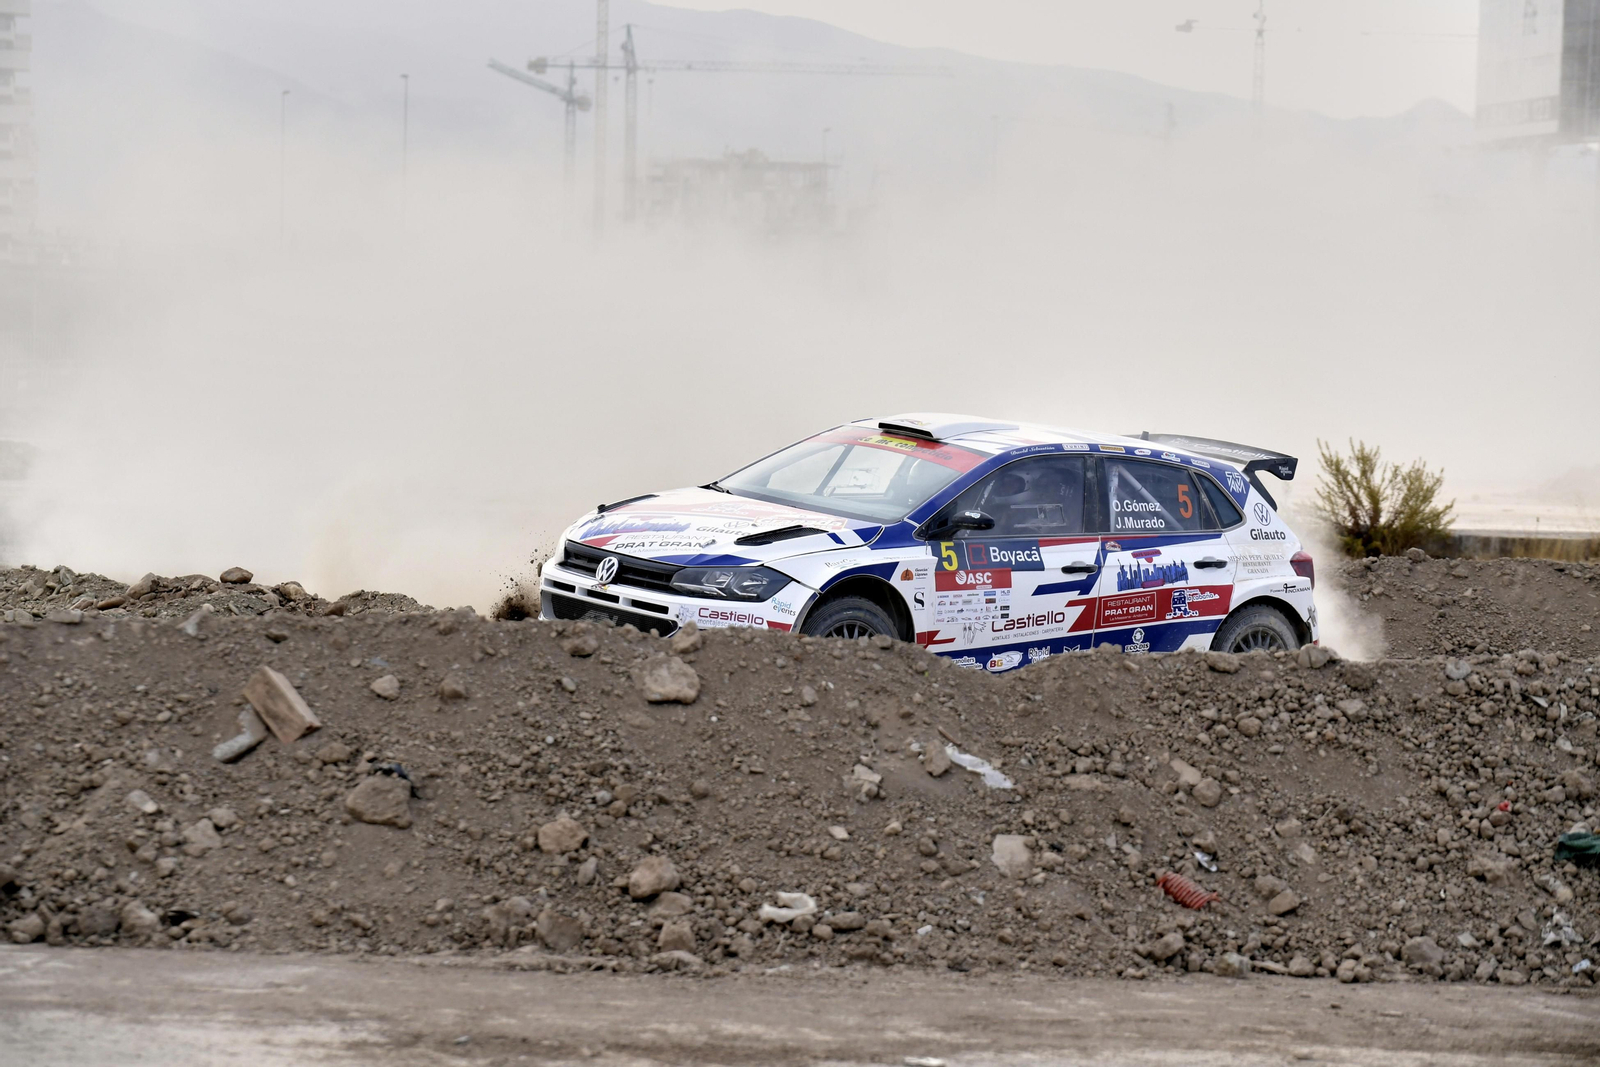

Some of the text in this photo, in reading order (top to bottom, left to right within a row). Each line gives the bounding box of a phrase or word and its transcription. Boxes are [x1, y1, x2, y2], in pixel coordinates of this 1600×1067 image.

[1112, 499, 1162, 512] O.Gómez
[1177, 484, 1193, 519] 5
[1115, 516, 1165, 529] J.Murado
[625, 533, 711, 541] RESTAURANT
[1249, 528, 1286, 541] Gilauto
[614, 541, 658, 550] PRAT
[940, 541, 959, 571] 5
[967, 572, 992, 585] ASC
[914, 591, 925, 608] S
[1107, 596, 1151, 607] RESTAURANT
[698, 607, 764, 626] Castiello
[1105, 604, 1153, 616] PRAT GRAN
[1013, 630, 1039, 638] INSTALACIONES
[952, 656, 975, 664] ranollers
[989, 659, 1003, 668] BG
